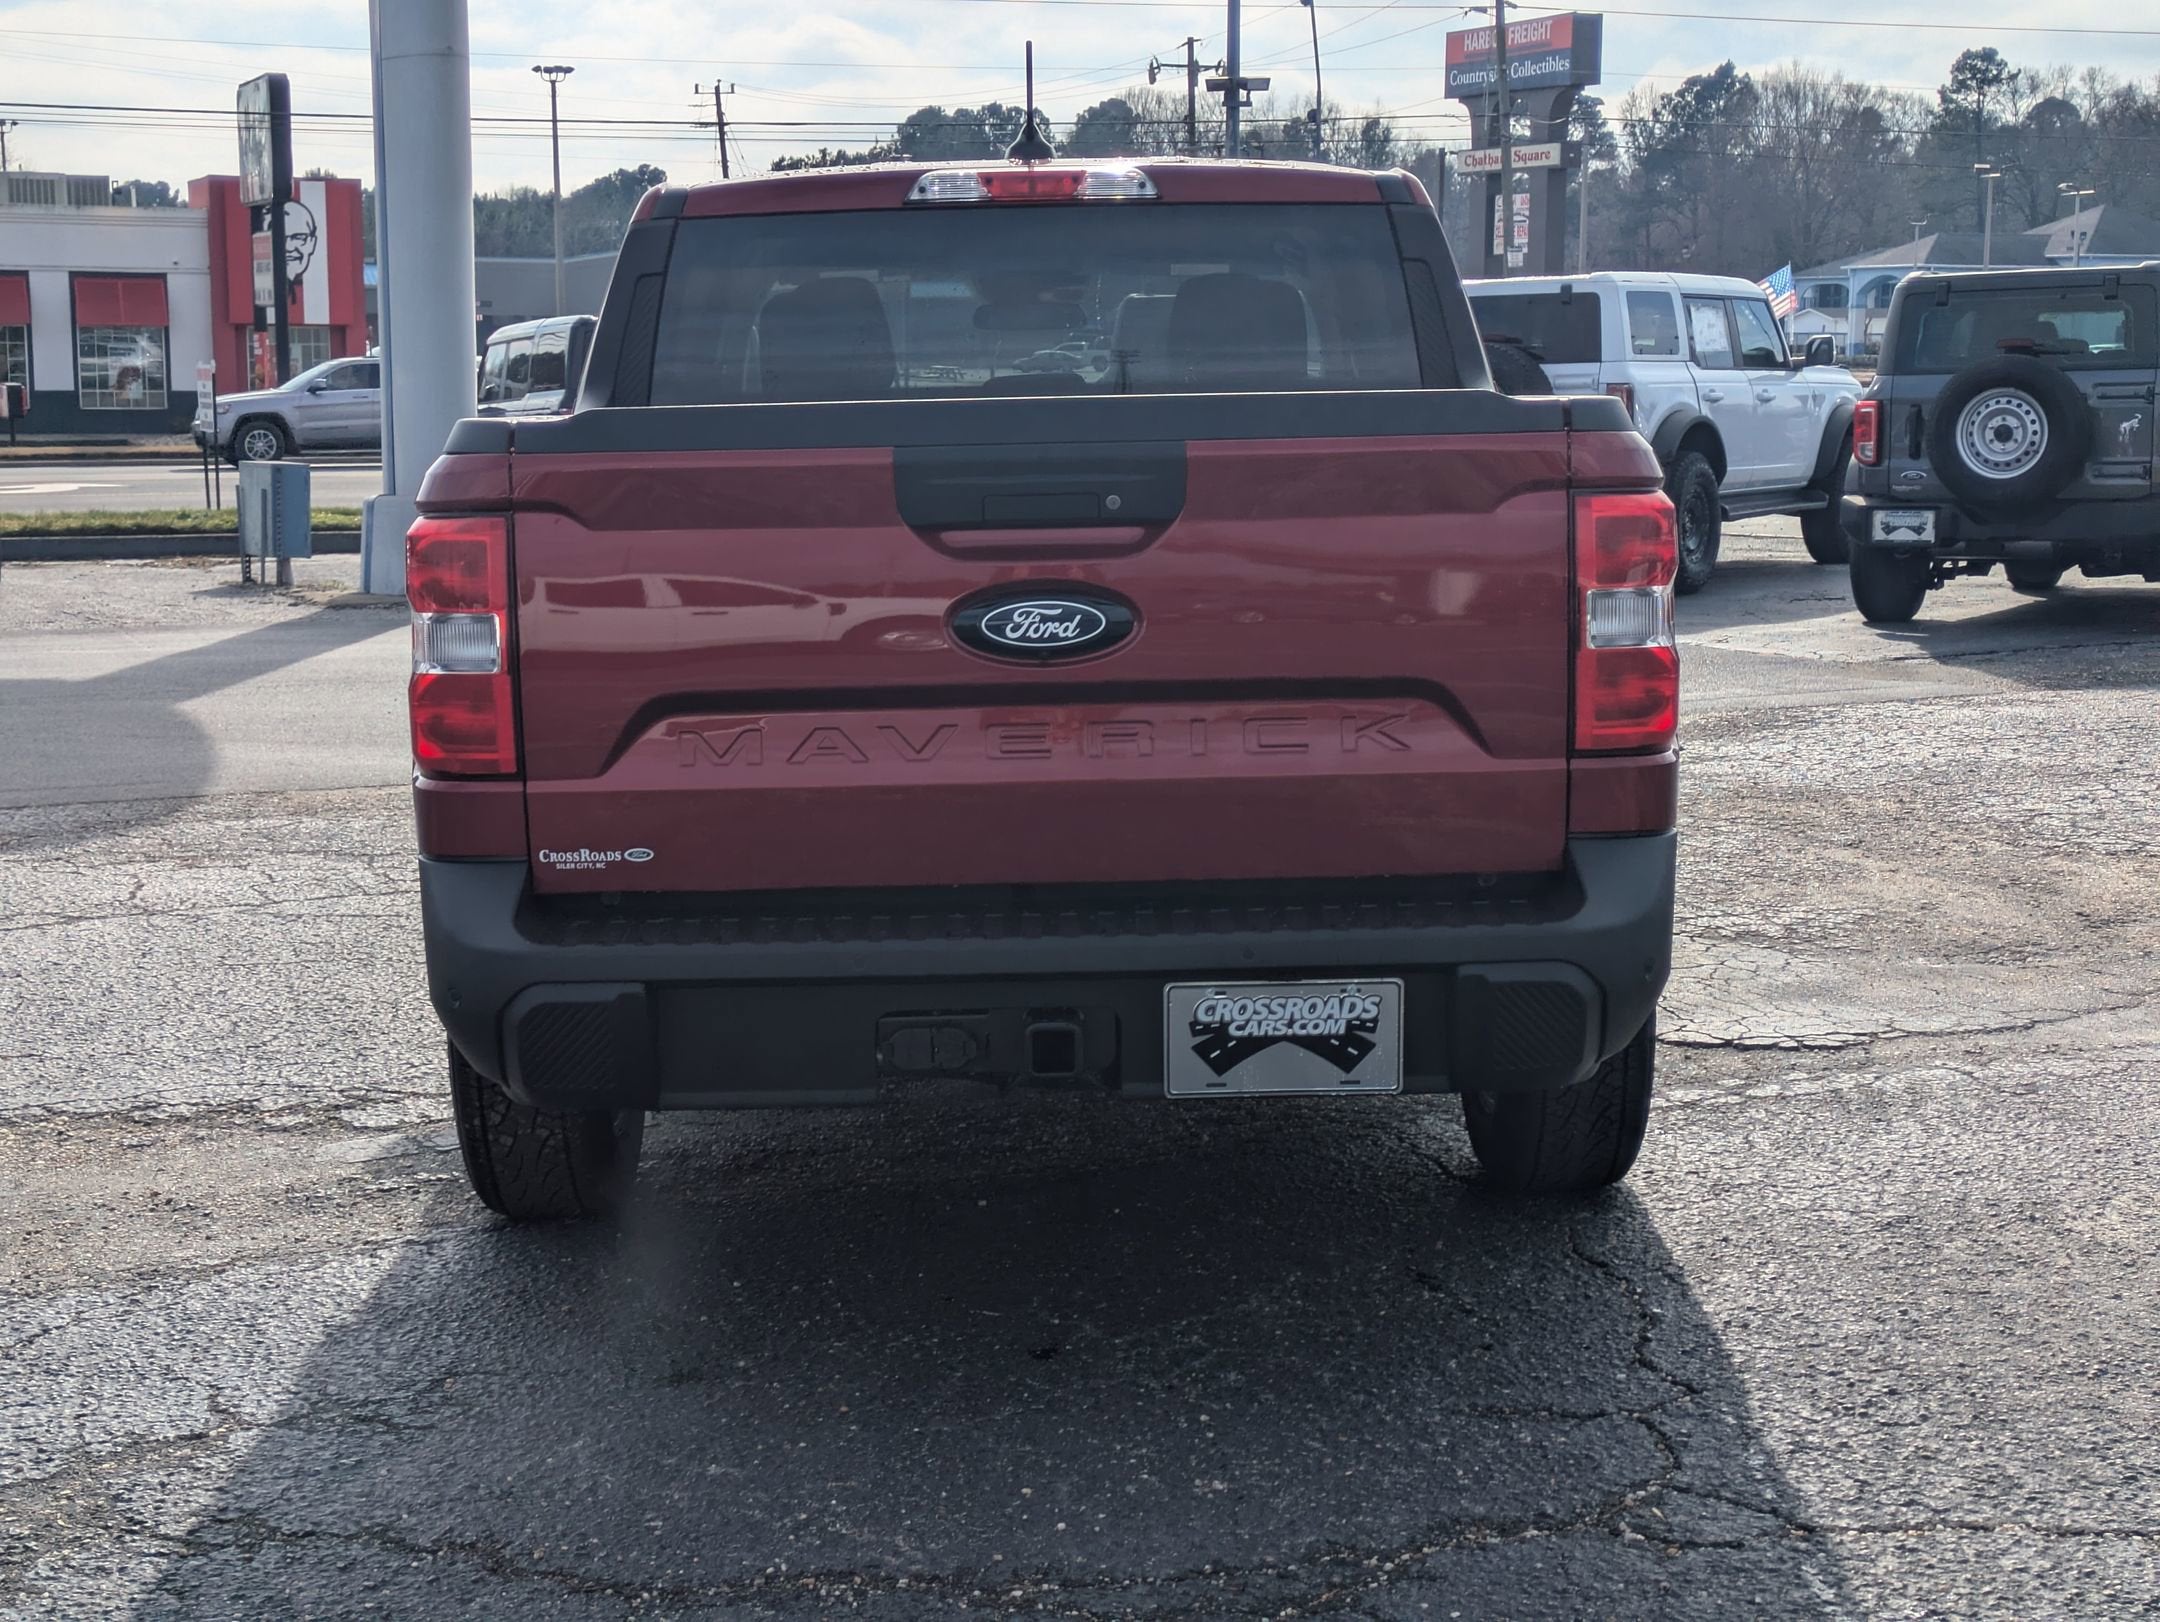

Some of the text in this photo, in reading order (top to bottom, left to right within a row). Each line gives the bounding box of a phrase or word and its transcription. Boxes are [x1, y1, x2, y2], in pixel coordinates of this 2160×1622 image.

[1464, 20, 1553, 52] HARBO FREIGHT
[1450, 56, 1570, 87] Countrysi Collectibles
[1464, 149, 1552, 168] Chatha Square
[1005, 607, 1083, 639] Ford
[678, 713, 1412, 768] MAVERICK
[1196, 996, 1380, 1022] CROSSROADS
[1227, 1018, 1348, 1038] CARS.COM
